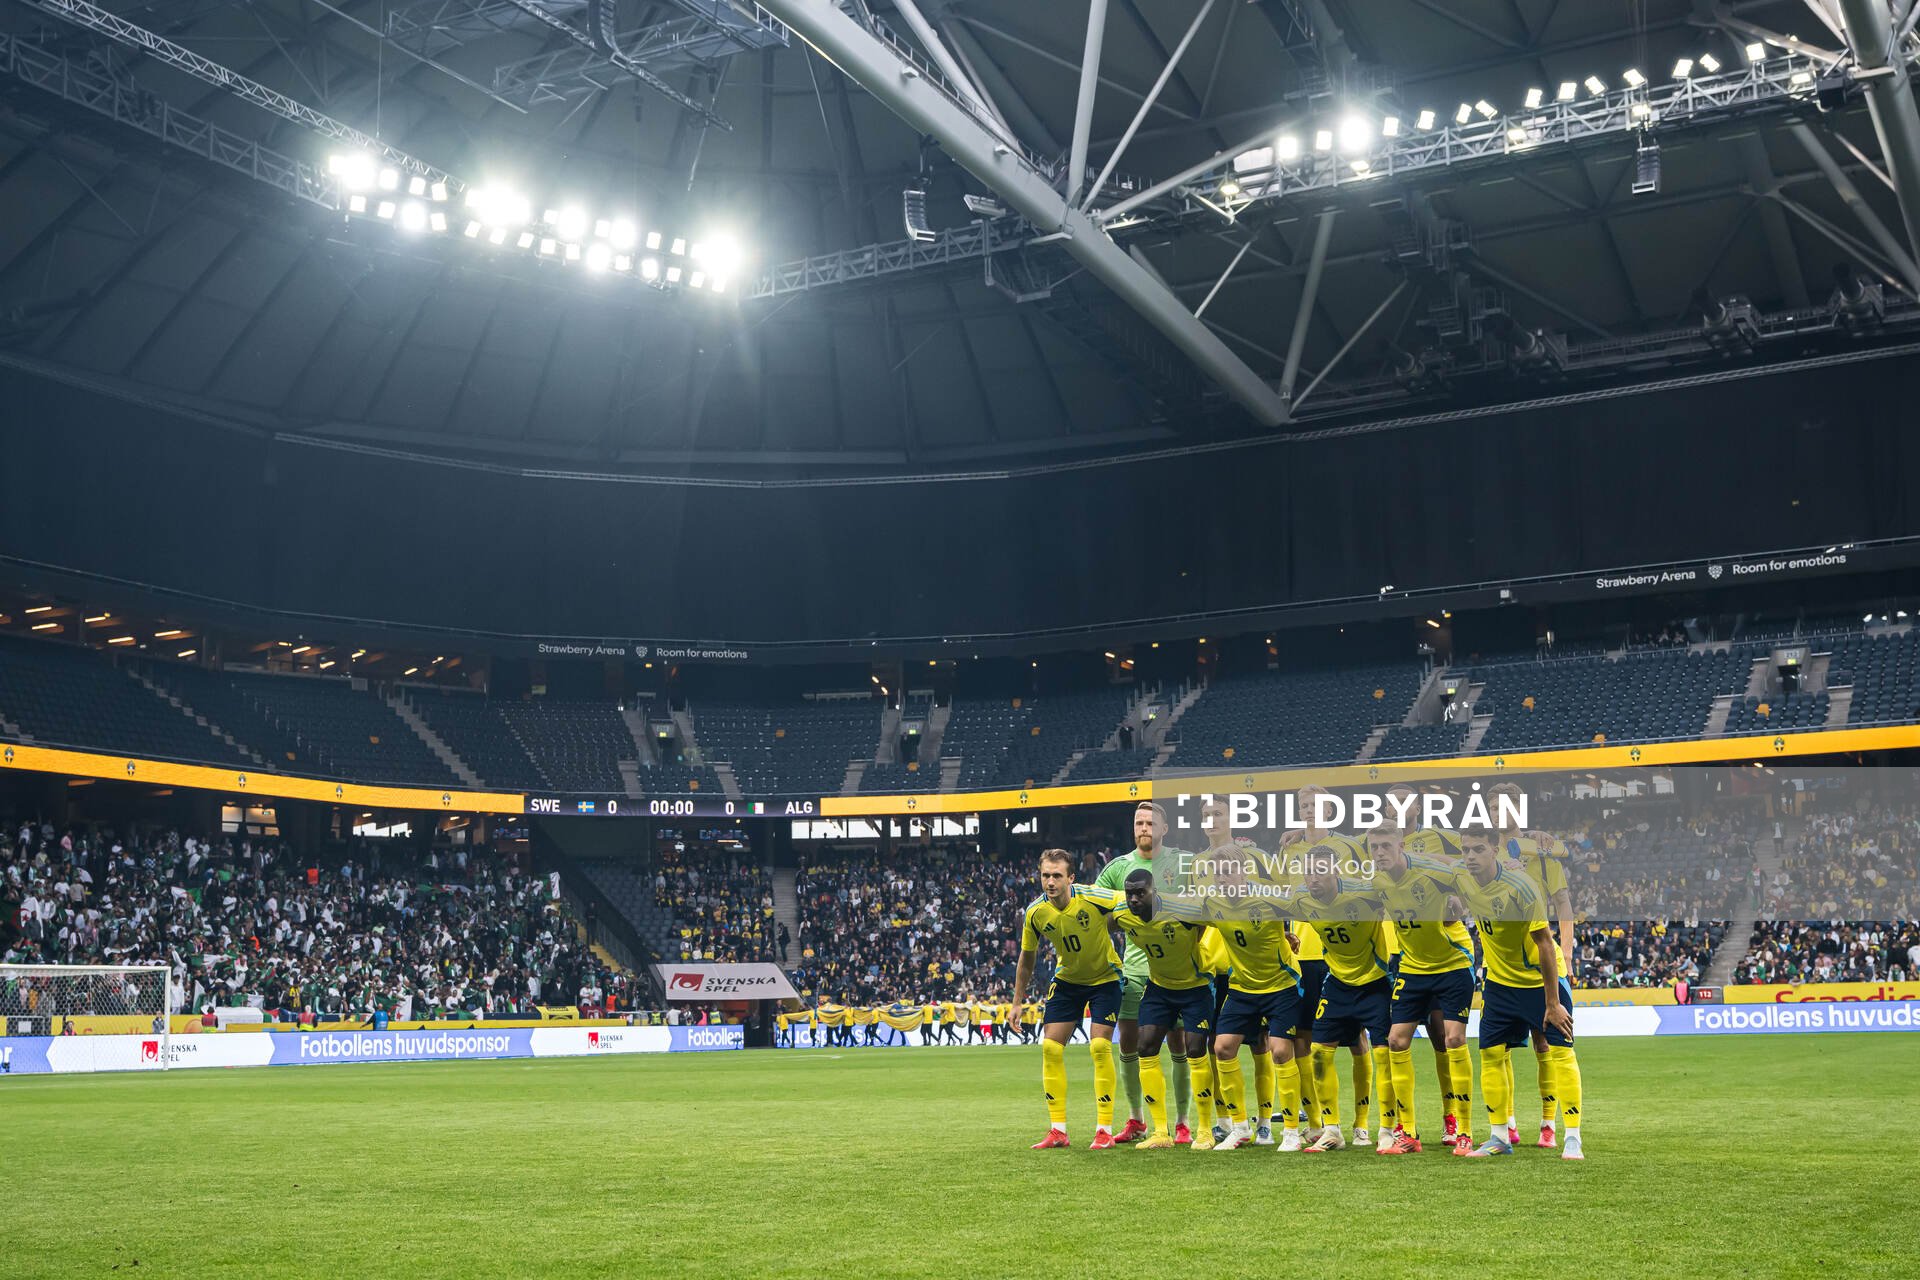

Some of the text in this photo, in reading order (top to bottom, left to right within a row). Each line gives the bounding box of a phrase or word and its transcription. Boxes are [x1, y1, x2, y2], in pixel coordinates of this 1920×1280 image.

[1732, 553, 1847, 575] Room for emotions
[1596, 570, 1696, 588] Strawberry Arena
[538, 643, 625, 657] Strawberry Arena
[656, 647, 748, 659] Room for emotions
[530, 799, 813, 815] SWE 0 00:00 0 ALG
[1394, 909, 1422, 929] 22
[1062, 934, 1082, 953] 10
[1234, 929, 1247, 947] 8
[1323, 927, 1351, 944] 26
[1146, 943, 1164, 959] 13
[704, 985, 740, 993] SPEL
[707, 976, 777, 985] SVENSKA
[1694, 1005, 1825, 1029] Fotbollens
[301, 1032, 511, 1057] Fotbollens huvudsponsor
[688, 1027, 744, 1047] Fotbollen
[161, 1044, 198, 1053] SENSKA
